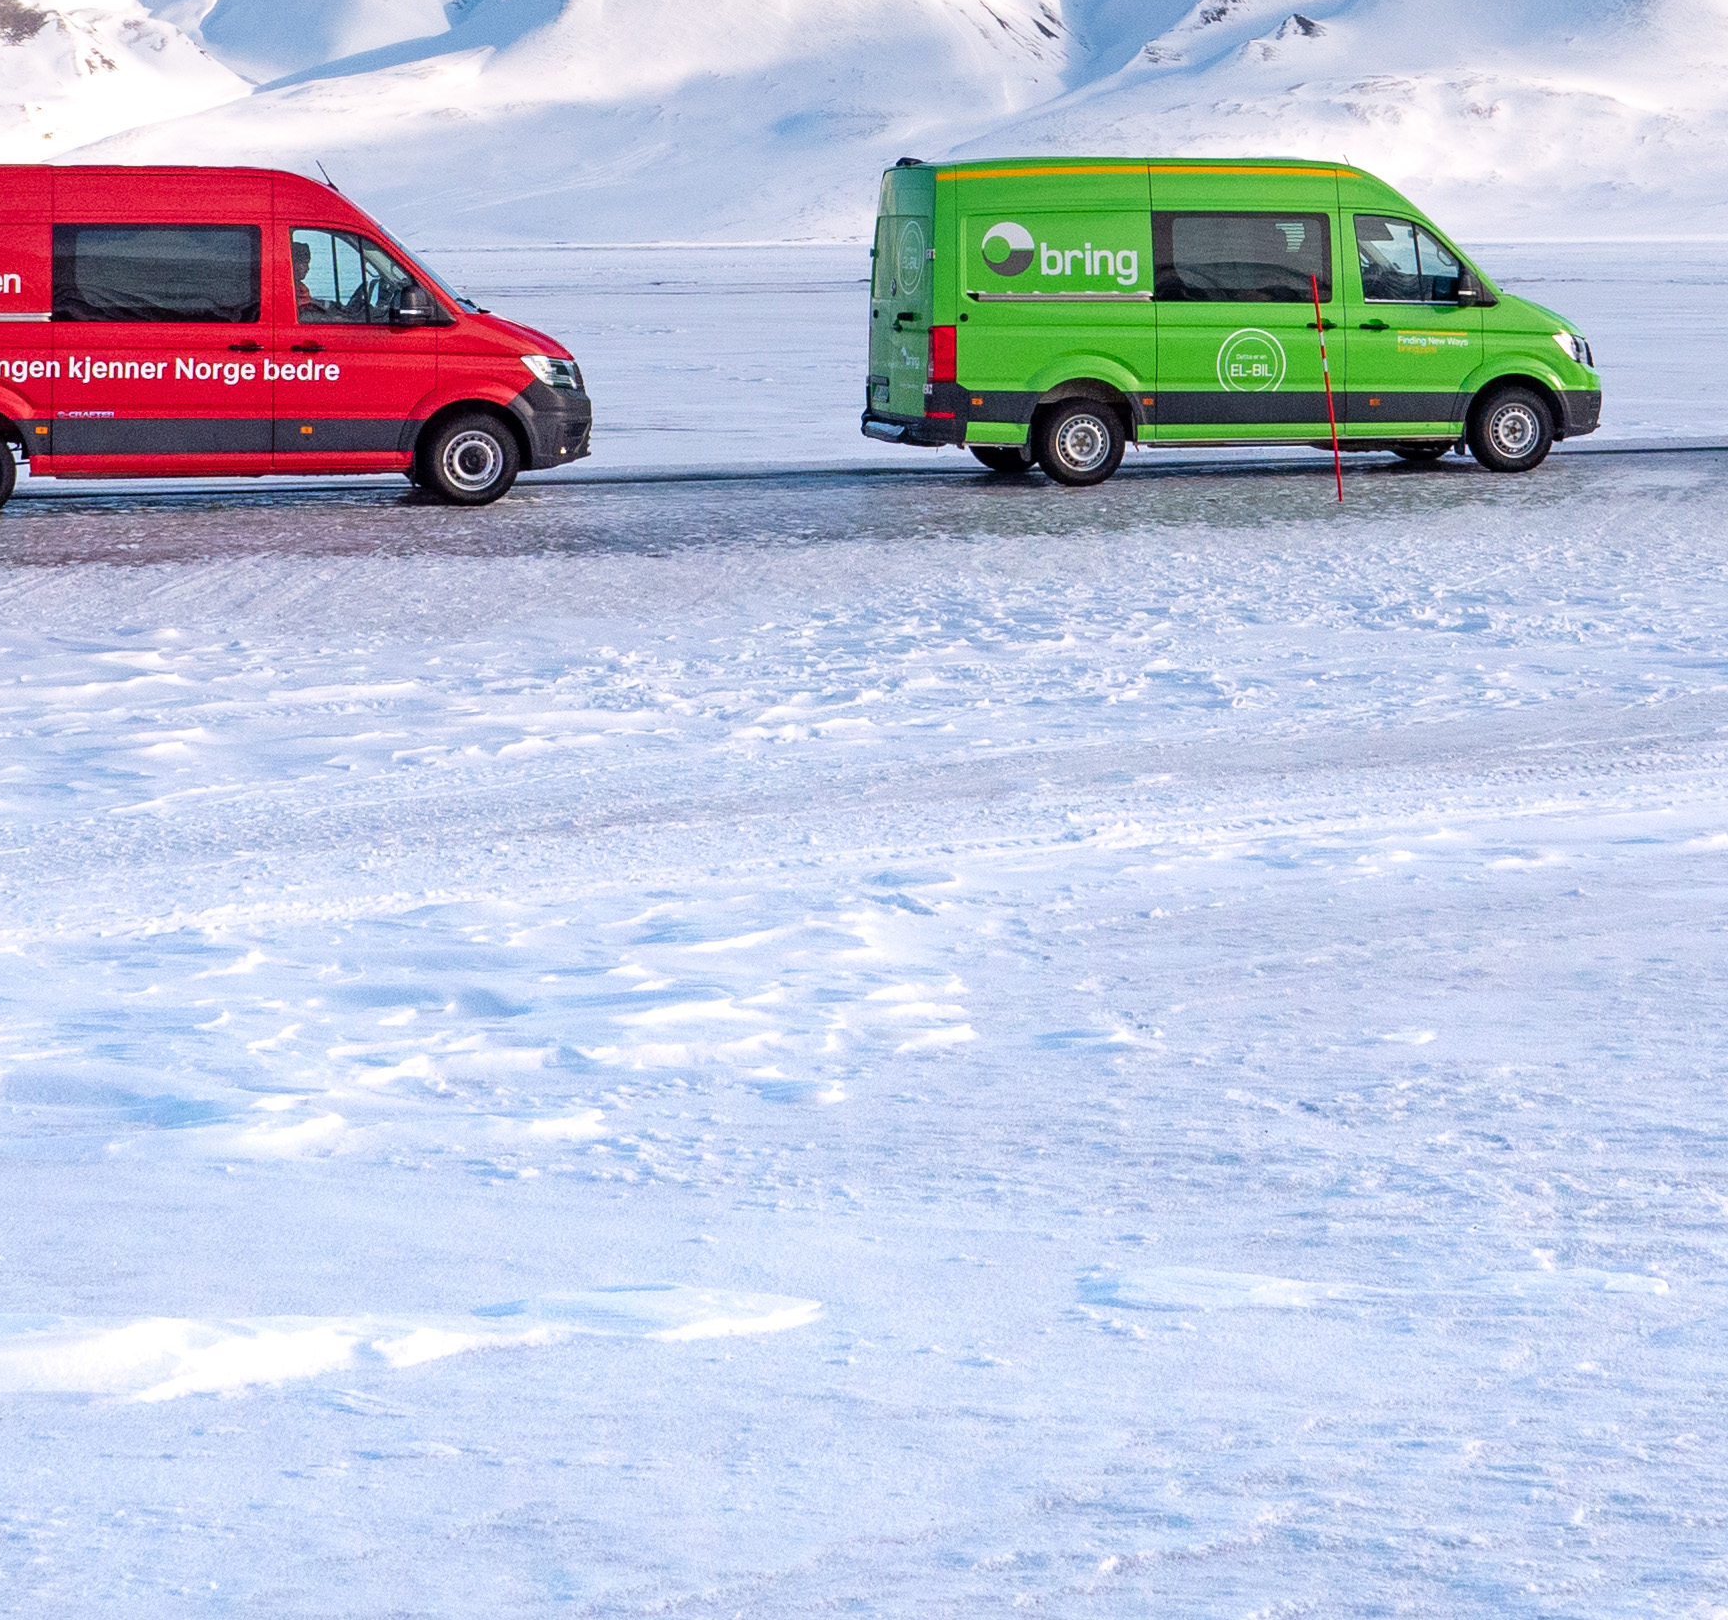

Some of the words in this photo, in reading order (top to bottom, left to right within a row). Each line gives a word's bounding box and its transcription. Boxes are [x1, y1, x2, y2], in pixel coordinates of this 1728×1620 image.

[1040, 242, 1139, 286] bring
[1397, 335, 1427, 347] Finding
[1428, 336, 1446, 345] New
[1447, 337, 1469, 347] Ways
[68, 356, 168, 384] kjenner
[175, 357, 256, 386] Norge
[263, 358, 341, 381] bedre
[1231, 363, 1273, 377] EL-BIL
